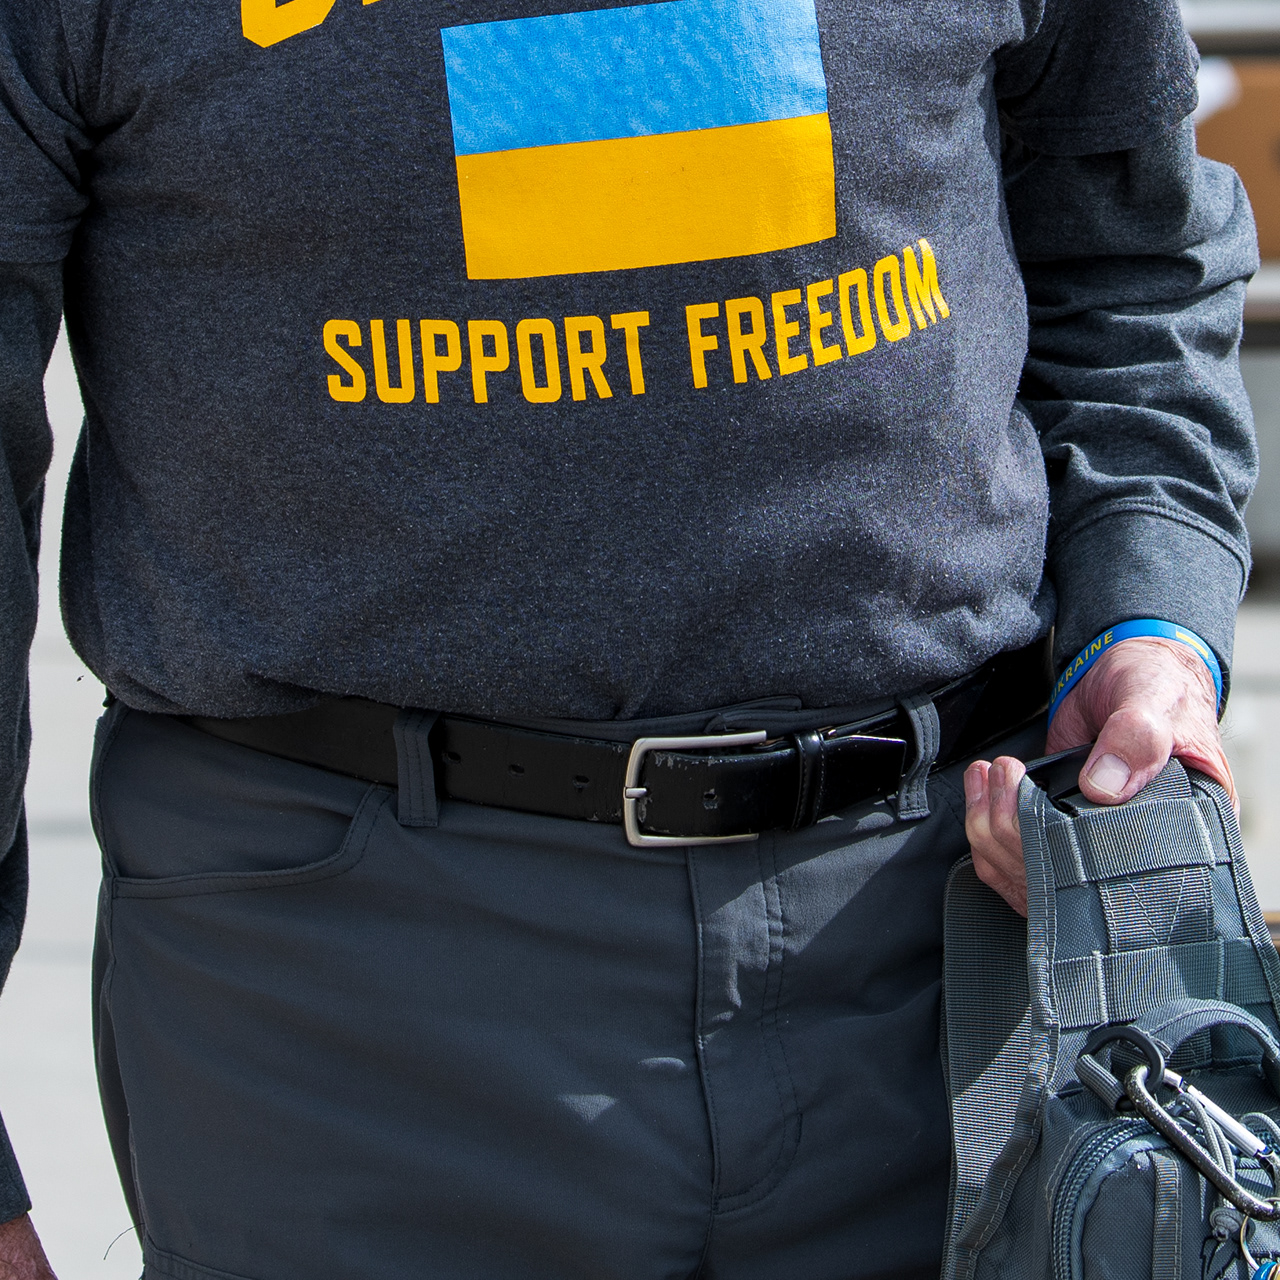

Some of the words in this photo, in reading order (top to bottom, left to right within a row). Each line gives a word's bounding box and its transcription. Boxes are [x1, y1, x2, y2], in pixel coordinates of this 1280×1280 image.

[322, 310, 651, 404] SUPPORT
[684, 237, 951, 389] FREEDOM
[1050, 630, 1114, 704] UKRAINE
